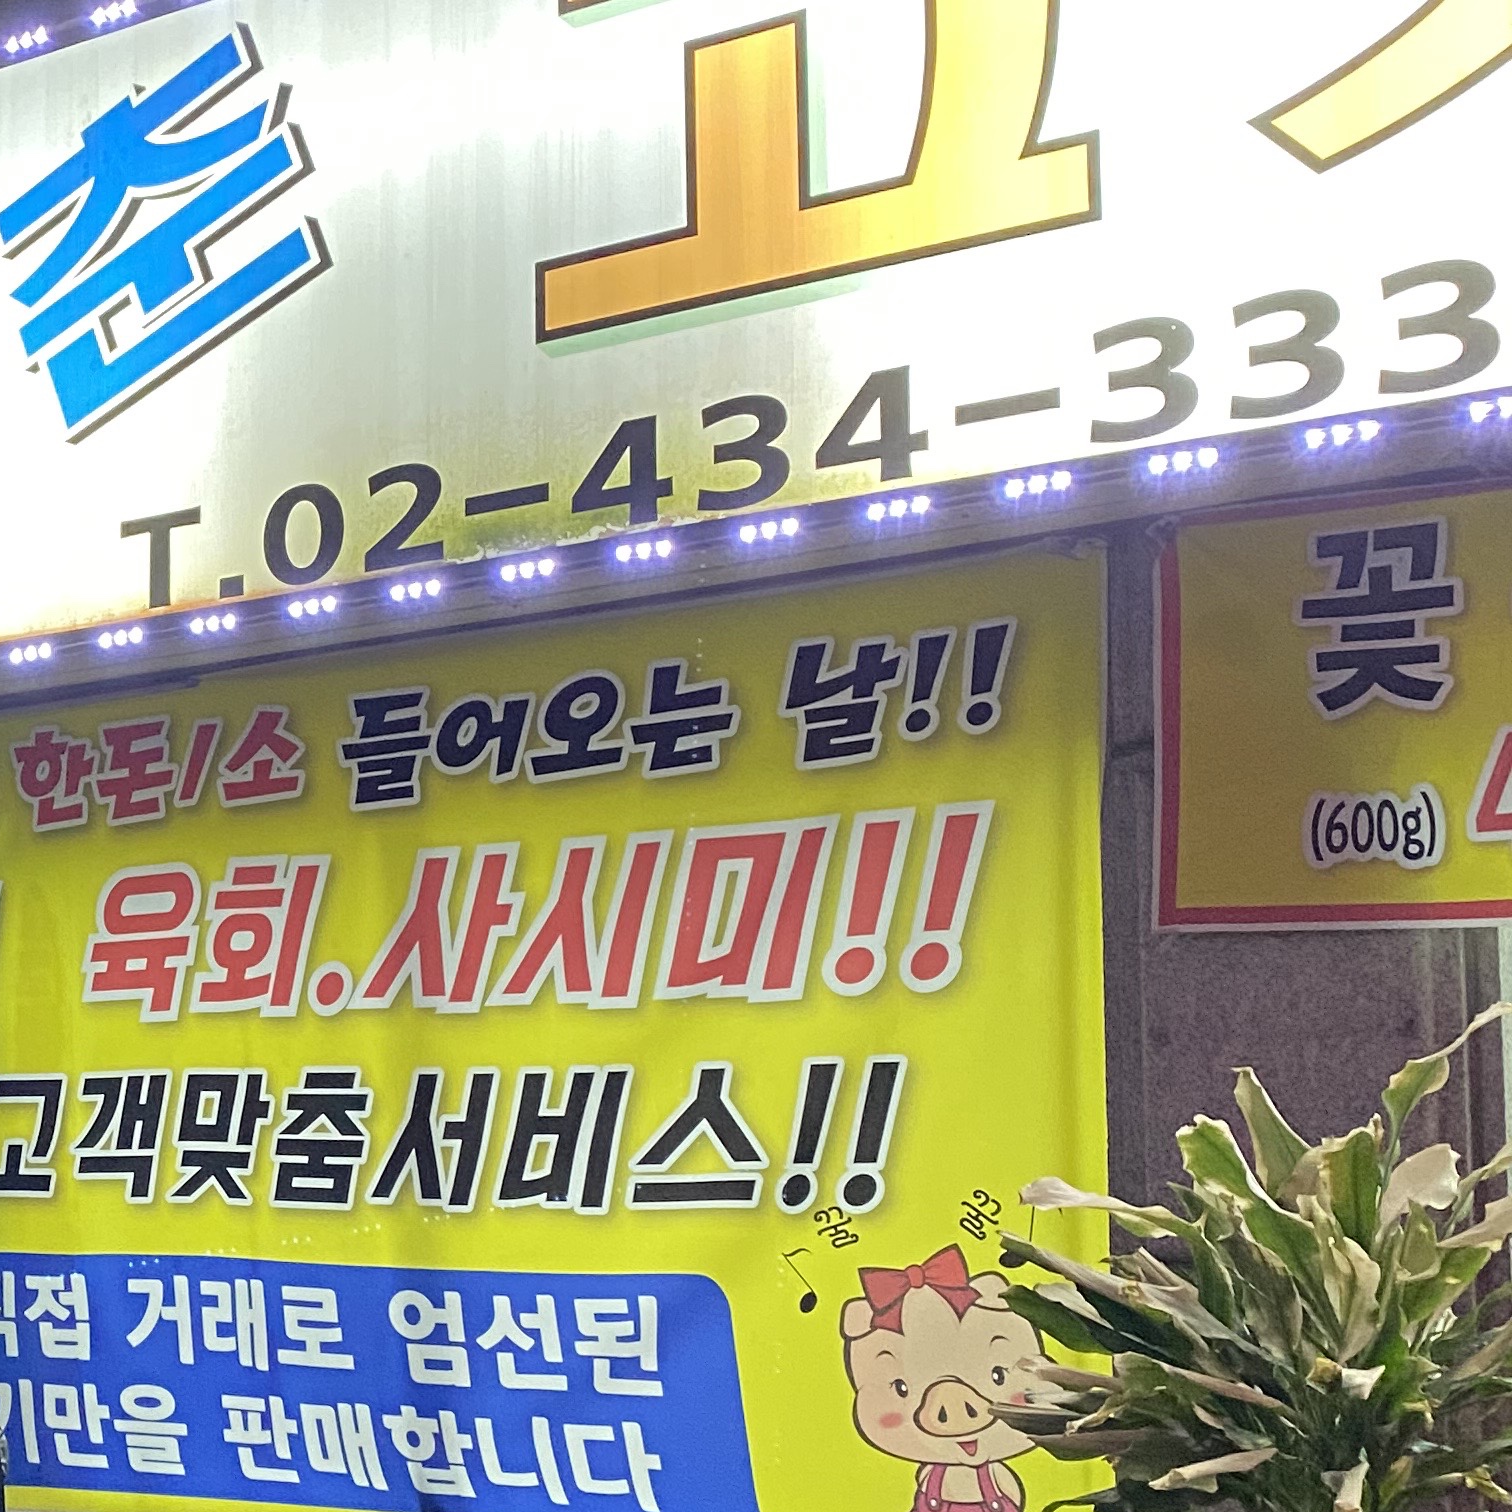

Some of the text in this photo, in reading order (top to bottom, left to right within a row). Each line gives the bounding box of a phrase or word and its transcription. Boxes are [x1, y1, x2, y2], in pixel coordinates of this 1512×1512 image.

[13, 709, 301, 828] 한돈/소
[341, 663, 736, 806] 들어오는
[785, 623, 1010, 763] 날!!
[1310, 790, 1437, 863] (600g)
[126, 1273, 356, 1372] 거래로
[388, 1289, 663, 1398] 엄선된
